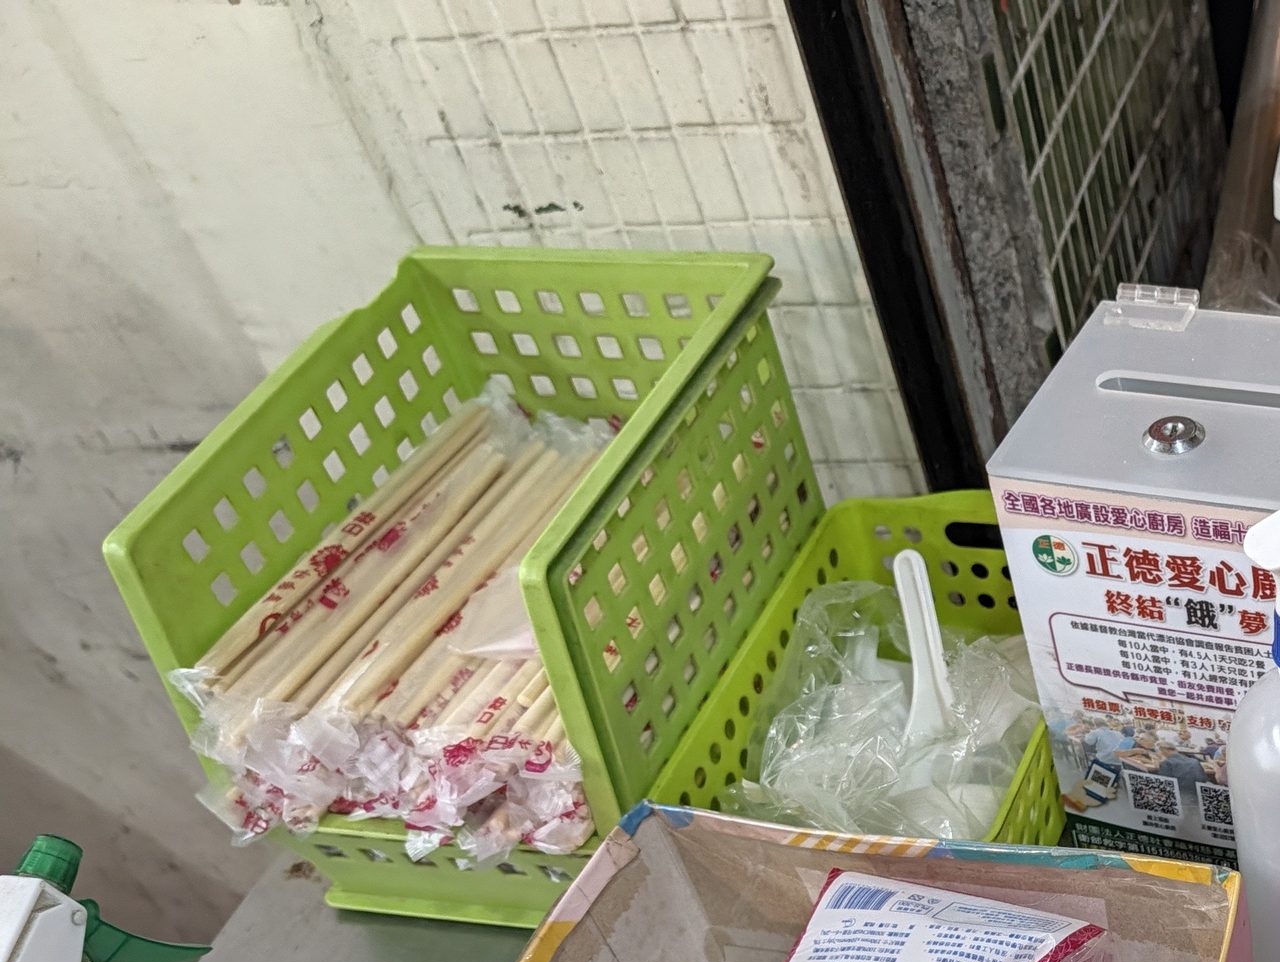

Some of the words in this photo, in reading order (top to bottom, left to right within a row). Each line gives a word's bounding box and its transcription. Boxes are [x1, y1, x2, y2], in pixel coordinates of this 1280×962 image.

[1003, 491, 1185, 537] 全國各地廣設愛心廚房
